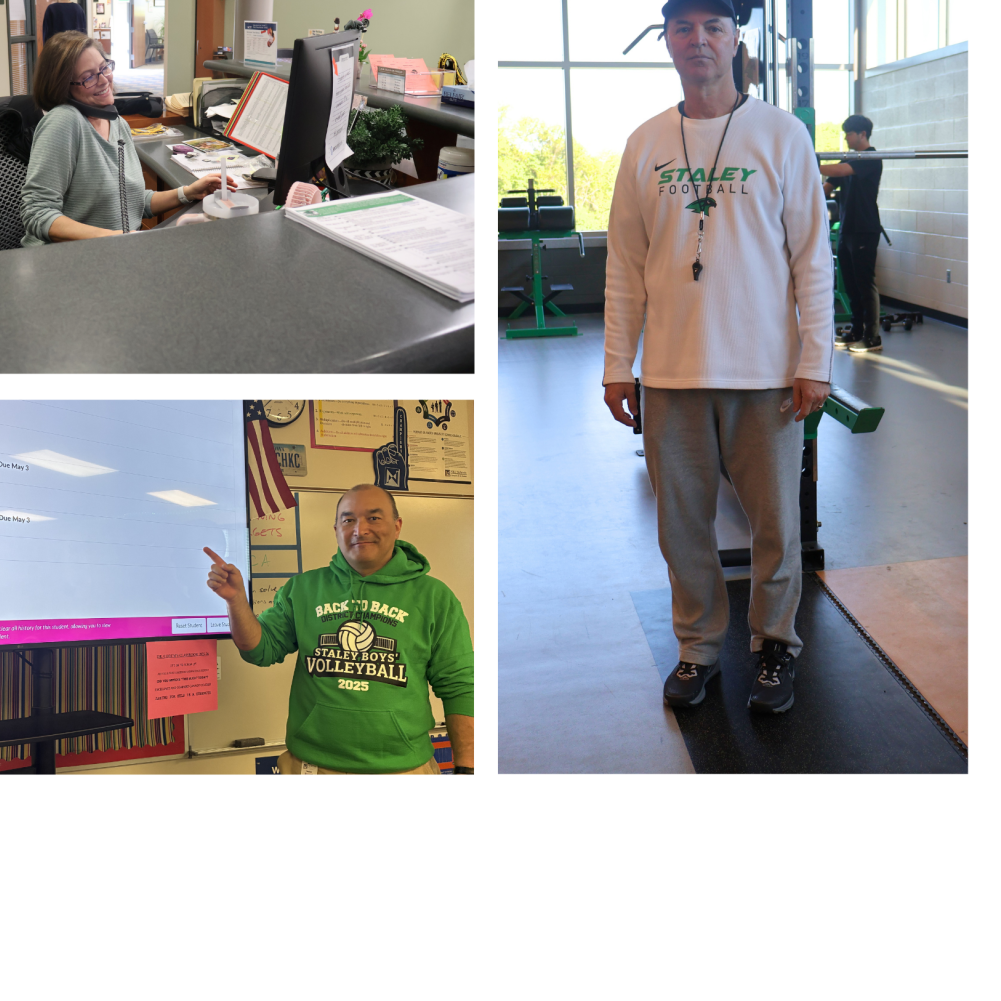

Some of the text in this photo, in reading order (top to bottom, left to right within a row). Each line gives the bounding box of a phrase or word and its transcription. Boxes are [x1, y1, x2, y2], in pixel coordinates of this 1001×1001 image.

[658, 167, 757, 185] STALEY
[659, 184, 748, 196] FOOTBALL
[294, 402, 299, 410] 4
[266, 408, 271, 418] 7
[287, 410, 292, 419] 5
[11, 463, 24, 471] May
[12, 516, 25, 524] May
[259, 584, 279, 593] solve
[315, 599, 409, 623] BACK TO BACK
[321, 611, 398, 627] DISTRICT CHAMPIONS
[314, 648, 399, 663] STALEY BOYS'
[307, 657, 407, 682] VOLLEYBALL
[338, 679, 369, 691] 2025
